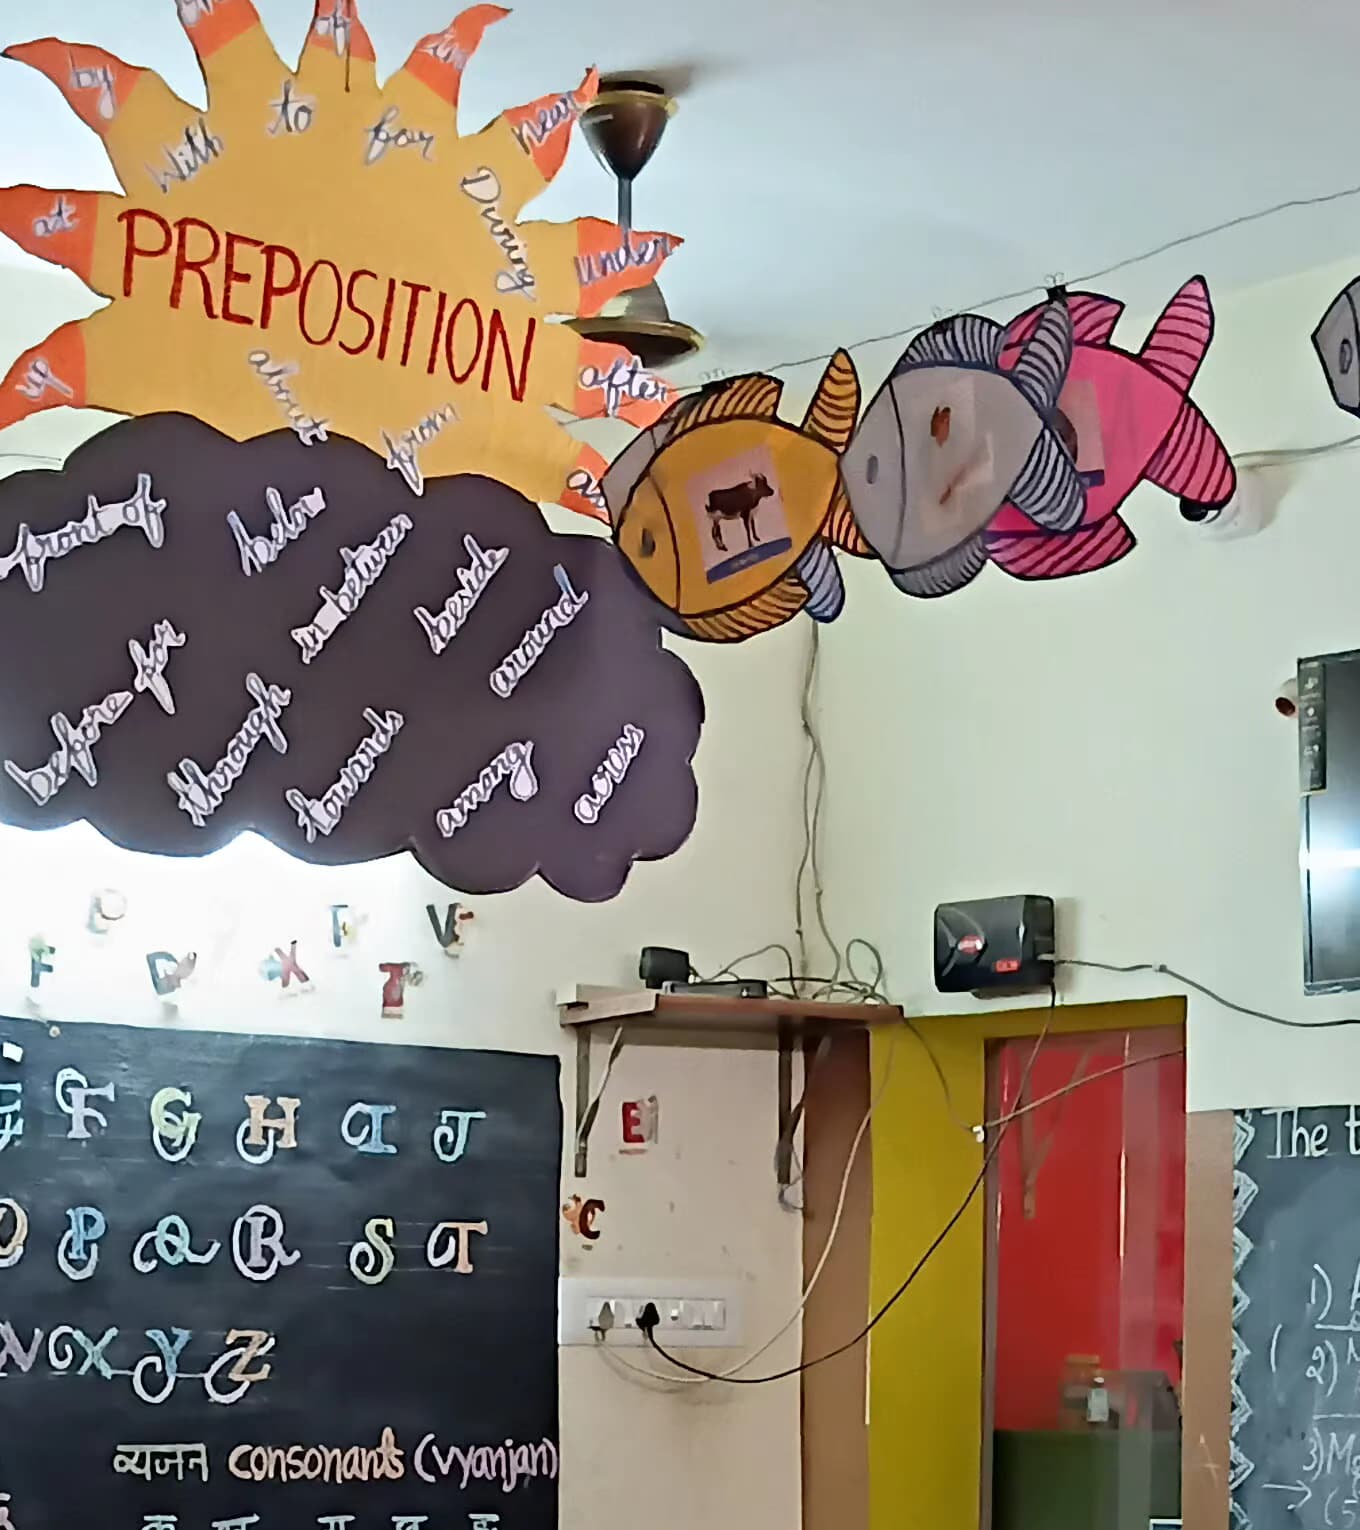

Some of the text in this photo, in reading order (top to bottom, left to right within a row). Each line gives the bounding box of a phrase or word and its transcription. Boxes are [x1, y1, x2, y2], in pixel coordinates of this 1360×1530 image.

[69, 48, 116, 120] by
[267, 80, 314, 134] to
[514, 89, 588, 154] near
[33, 197, 80, 237] at
[574, 232, 673, 286] under
[118, 208, 536, 402] PREPOSITION
[579, 355, 668, 418] after
[382, 406, 459, 496] from
[414, 535, 509, 654] beside
[490, 564, 588, 698] around
[167, 672, 292, 827] through
[437, 741, 538, 838] among
[426, 903, 462, 948] V
[275, 940, 309, 988] X
[56, 1068, 115, 1138] F
[150, 1087, 201, 1161] G
[237, 1095, 300, 1164] H
[342, 1102, 397, 1154] I
[434, 1110, 486, 1162] J
[622, 1102, 645, 1143] E
[1262, 1107, 1329, 1159] The
[58, 1207, 106, 1280] P
[133, 1214, 221, 1272] Q
[232, 1204, 300, 1281] R
[350, 1218, 393, 1284] S
[427, 1220, 487, 1274] T
[579, 1199, 605, 1239] C
[48, 1326, 118, 1379] X
[133, 1327, 191, 1403] Y
[204, 1329, 275, 1404] Z
